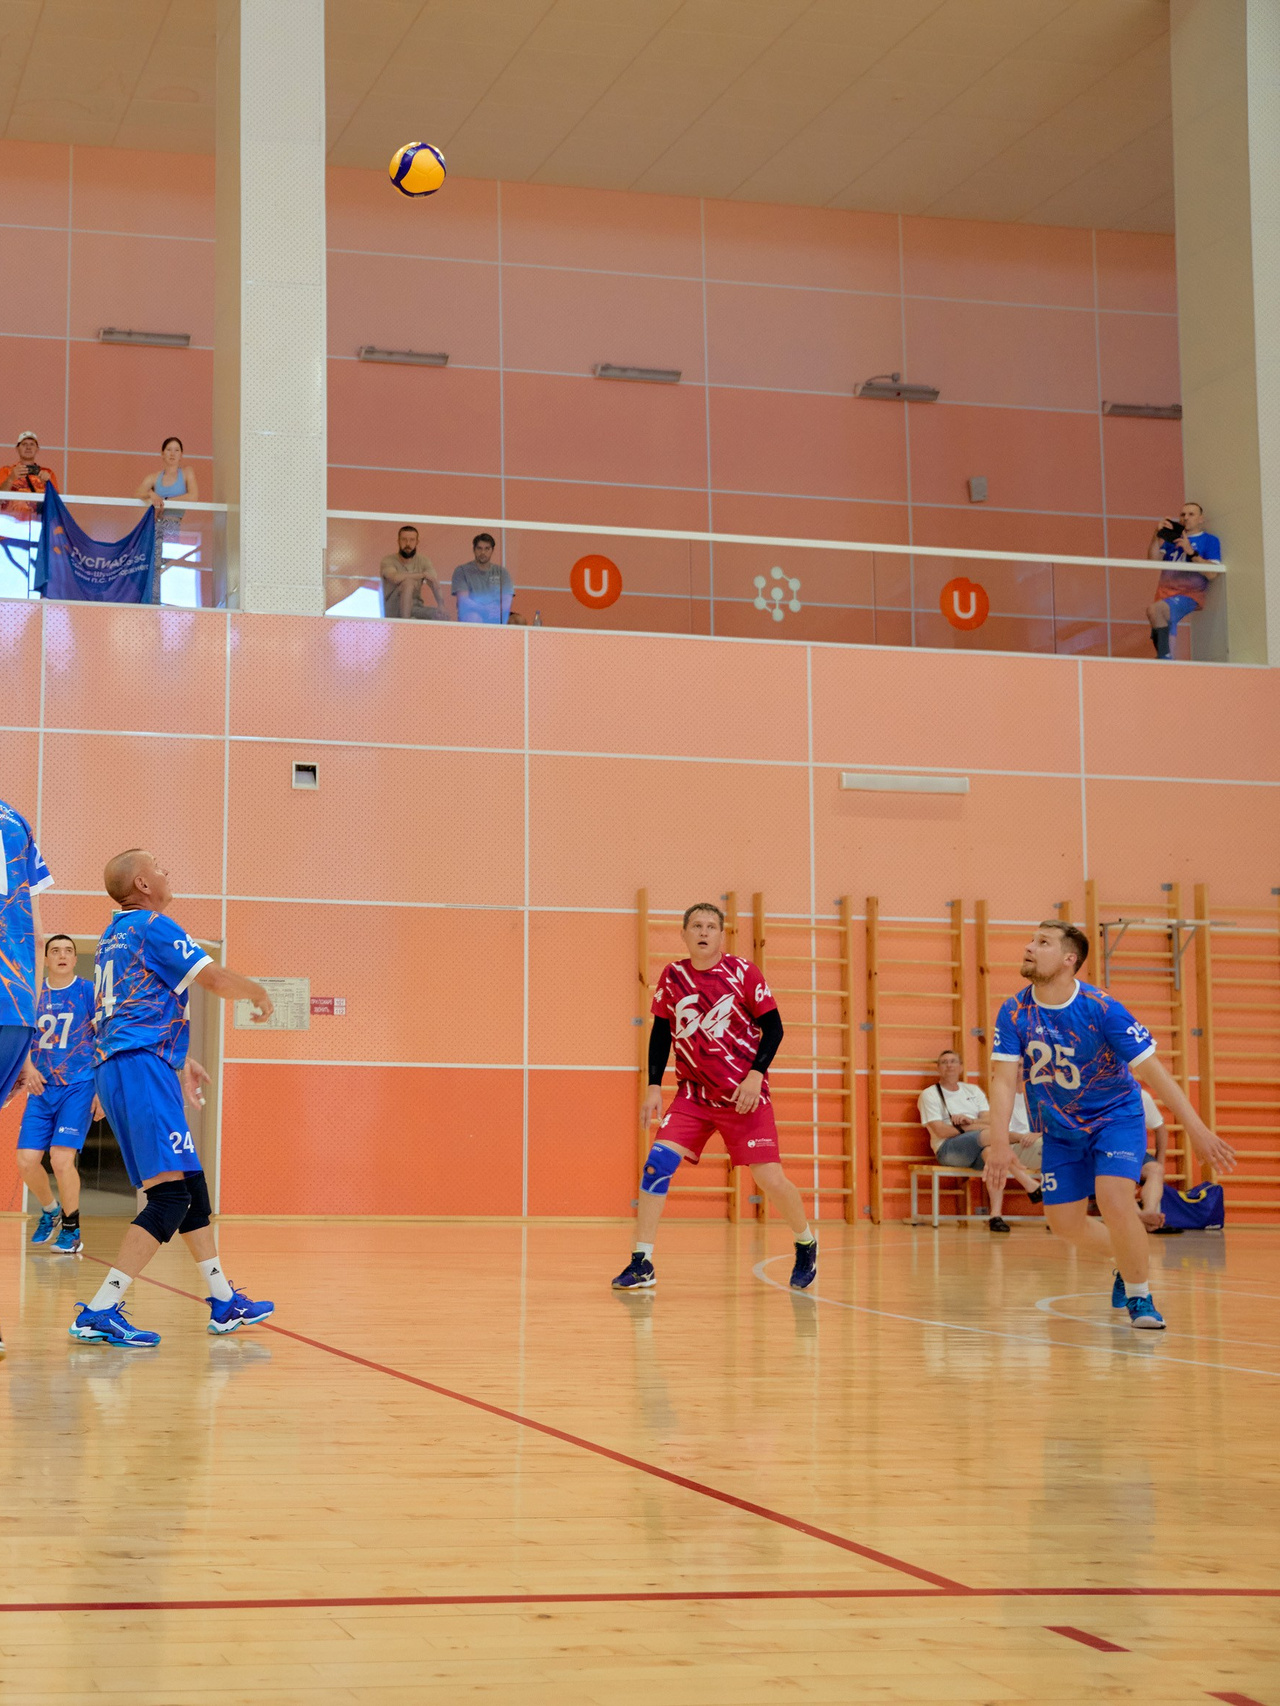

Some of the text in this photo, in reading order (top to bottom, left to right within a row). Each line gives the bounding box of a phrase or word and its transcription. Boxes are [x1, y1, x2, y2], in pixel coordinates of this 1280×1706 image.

[584, 568, 608, 597] U
[953, 590, 976, 619] U
[173, 933, 202, 960] 24
[754, 982, 772, 1005] 64
[675, 993, 736, 1039] 64
[38, 1012, 74, 1050] 27
[1126, 1021, 1151, 1044] 25
[1025, 1040, 1081, 1090] 25
[168, 1131, 195, 1154] 24
